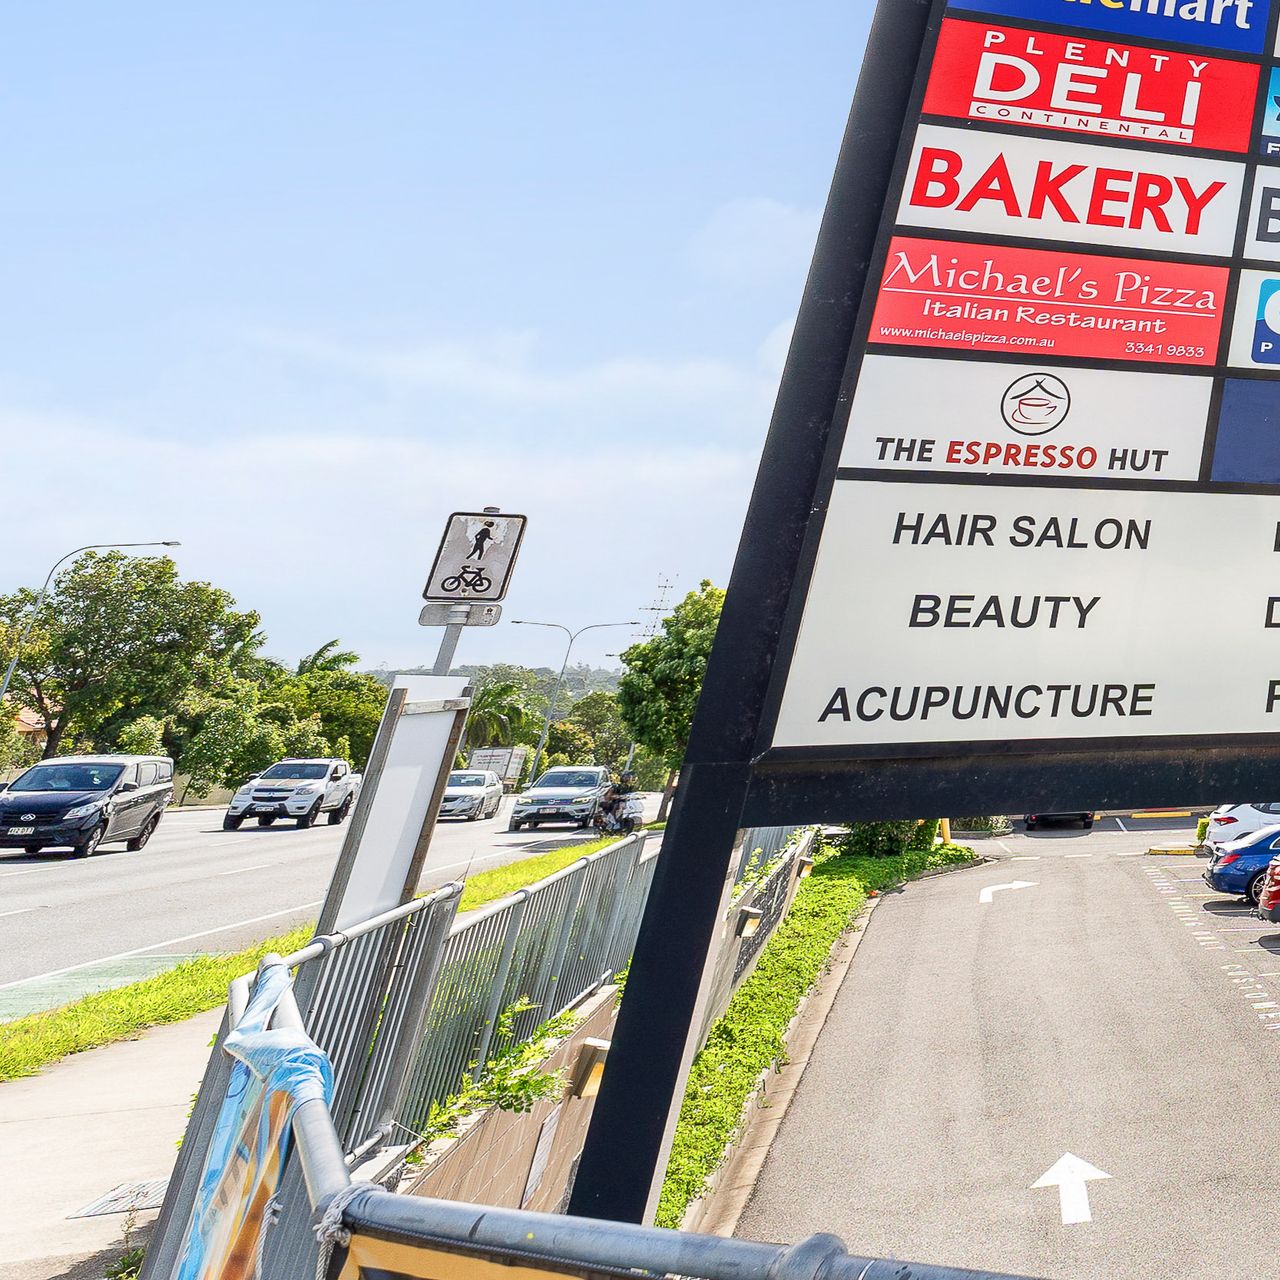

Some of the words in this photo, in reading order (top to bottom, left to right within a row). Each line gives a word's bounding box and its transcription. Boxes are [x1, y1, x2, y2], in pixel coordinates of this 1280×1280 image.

[984, 30, 1209, 78] PLENTY
[973, 52, 1202, 127] DELI
[975, 104, 1188, 141] CONTINENTAL
[909, 147, 1227, 236] BAKERY
[882, 252, 1099, 301] Michael's
[1114, 269, 1217, 313] Pizza
[922, 298, 1010, 323] Italian
[1015, 304, 1167, 335] Restaurant
[879, 325, 1056, 349] www.michaelspizza.com.au
[1125, 340, 1163, 357] 3341
[1165, 343, 1205, 360] 9833
[875, 436, 936, 464] THE
[946, 440, 1097, 470] ESPRESSO
[1107, 447, 1169, 473] HUT
[891, 512, 998, 548] HAIR
[1009, 515, 1152, 551] SALON
[908, 595, 1101, 630] BEAUTY
[818, 683, 1156, 723] ACUPUNCTURE
